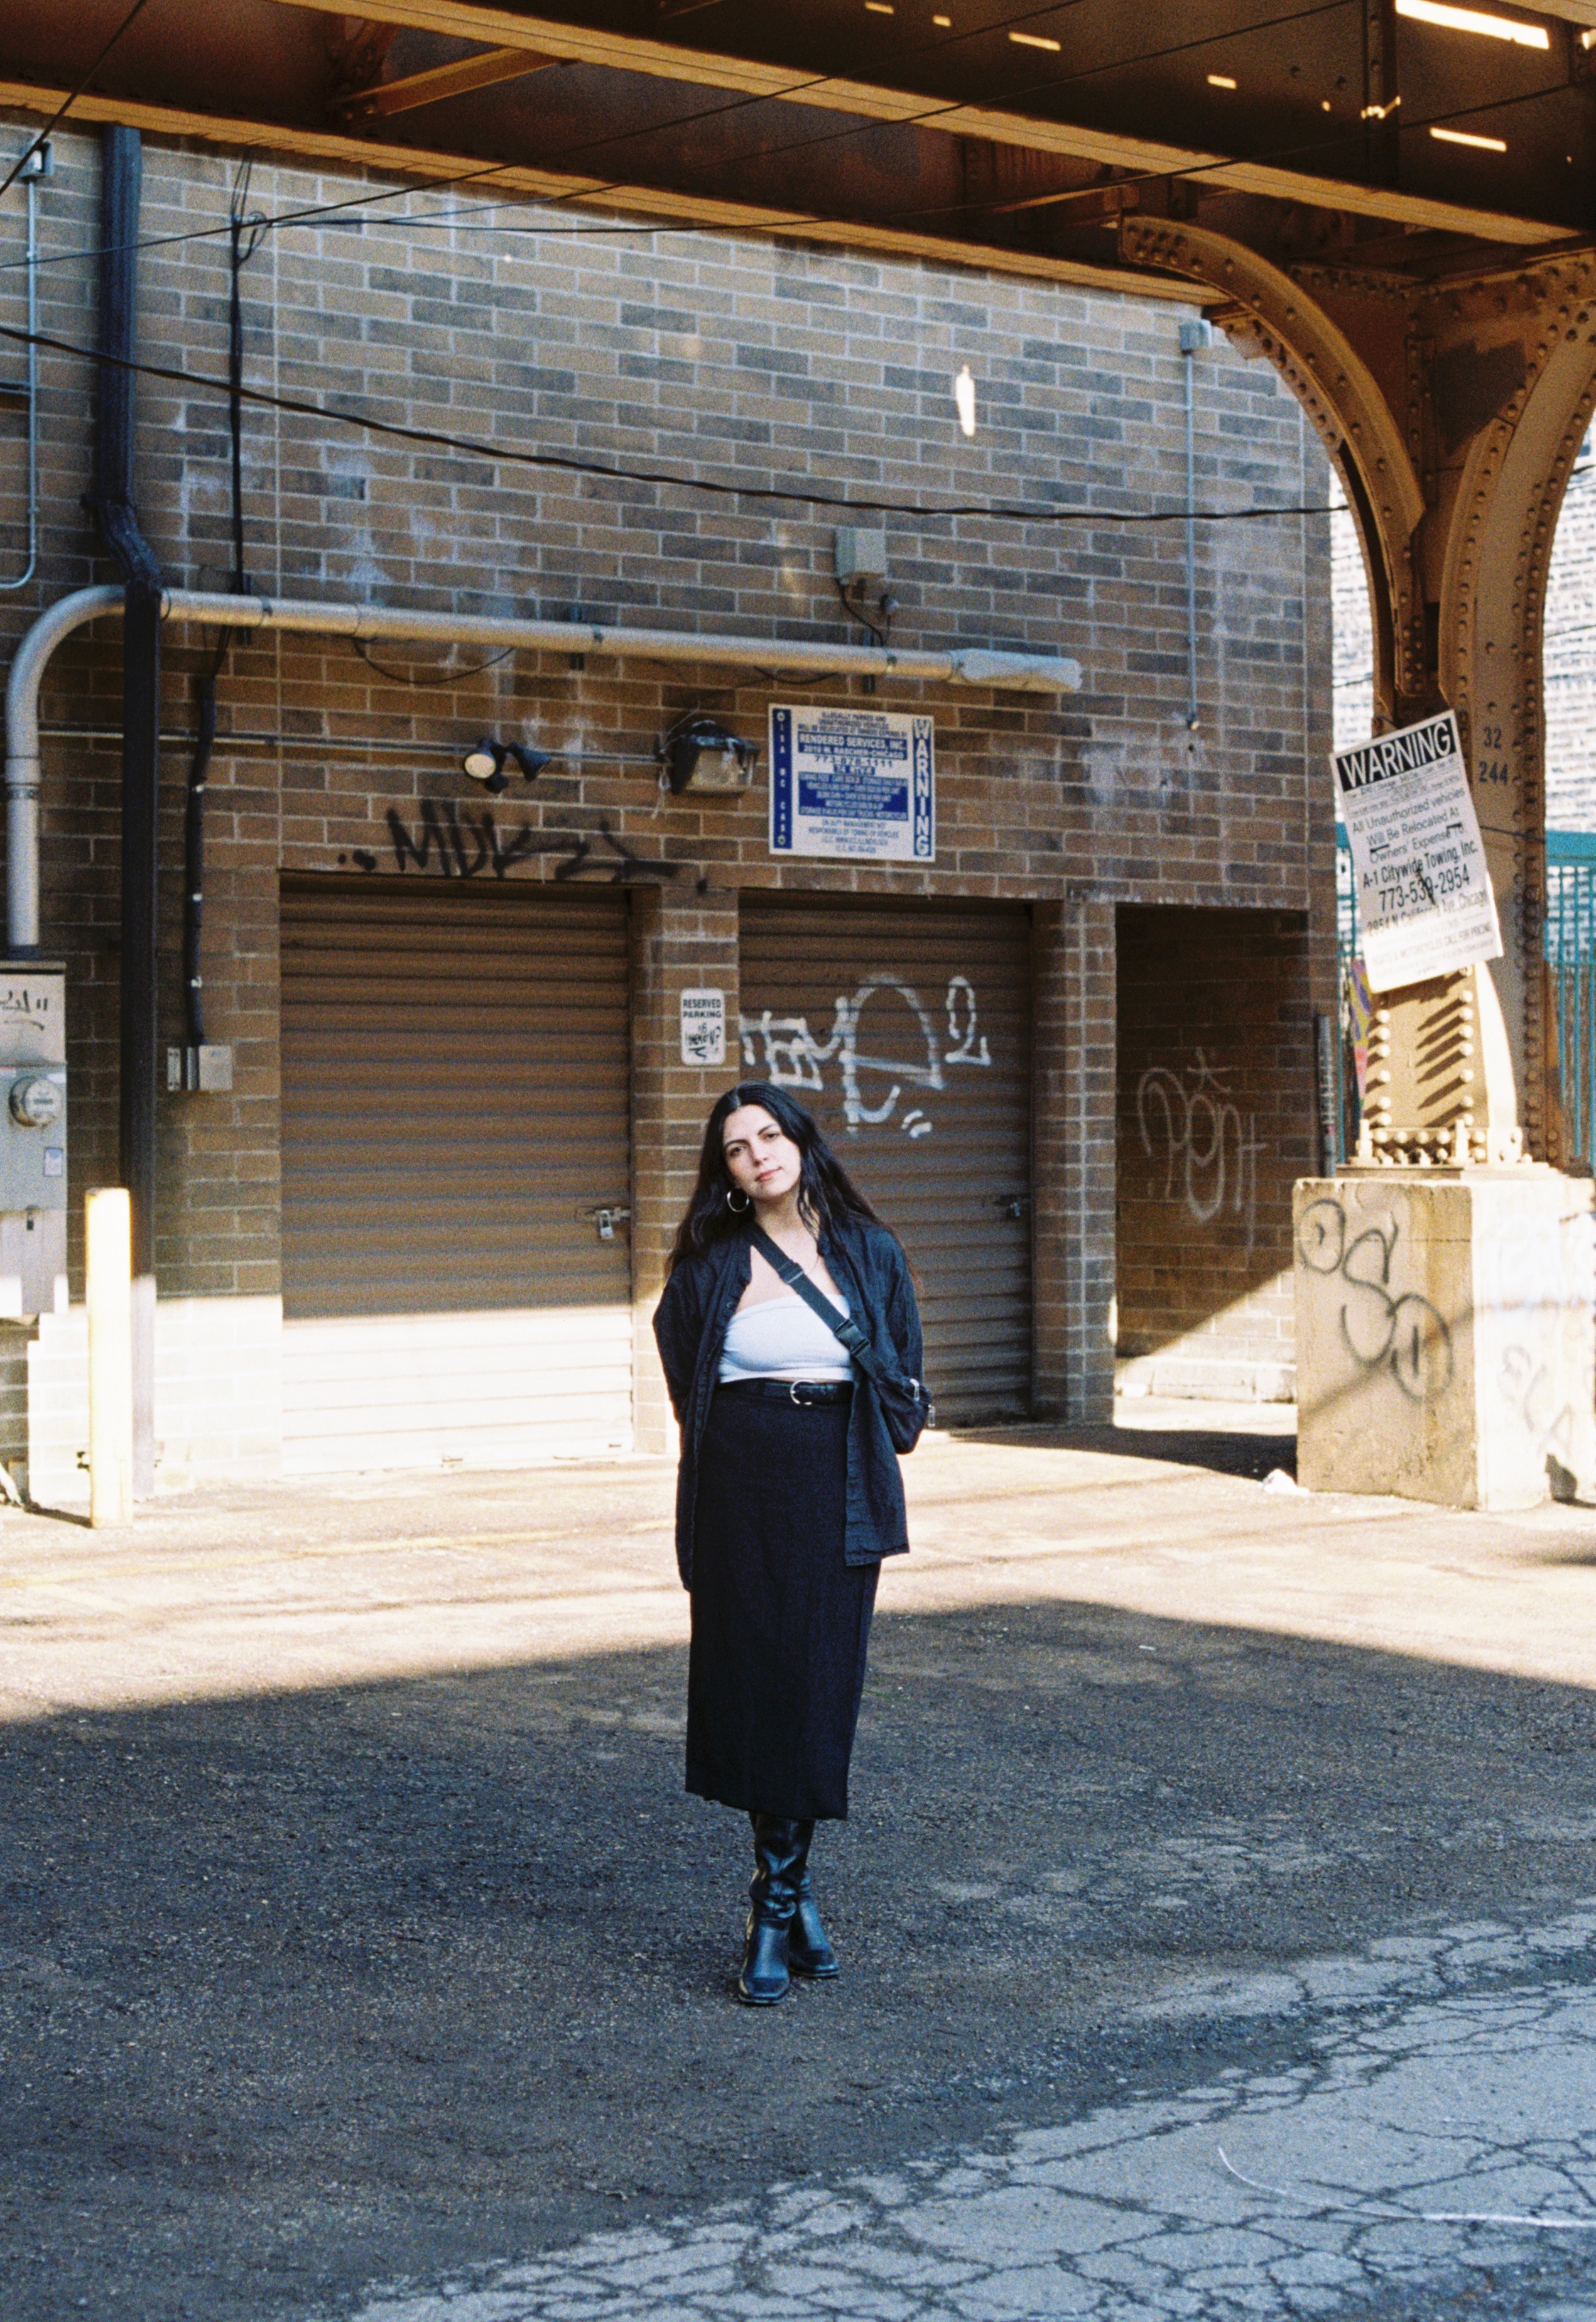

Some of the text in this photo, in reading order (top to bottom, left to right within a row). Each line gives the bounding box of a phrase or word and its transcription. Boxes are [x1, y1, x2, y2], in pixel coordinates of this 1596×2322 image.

[800, 734, 844, 746] RENDERED
[1342, 721, 1452, 788] WARNING
[1484, 726, 1502, 749] 32
[913, 719, 930, 856] WARNING
[1479, 761, 1507, 785] 244
[1354, 820, 1364, 834] All
[1366, 799, 1429, 829] Unauthorized
[1431, 787, 1465, 807] vehicles
[1367, 807, 1459, 846] Will Be Relocated At
[1413, 829, 1451, 849] Expense
[1363, 869, 1378, 888] A-1
[1381, 857, 1423, 882] Citywide
[1461, 840, 1479, 856] Inc.
[1379, 863, 1470, 912] 773-539-2954
[683, 999, 721, 1008] RESERVED
